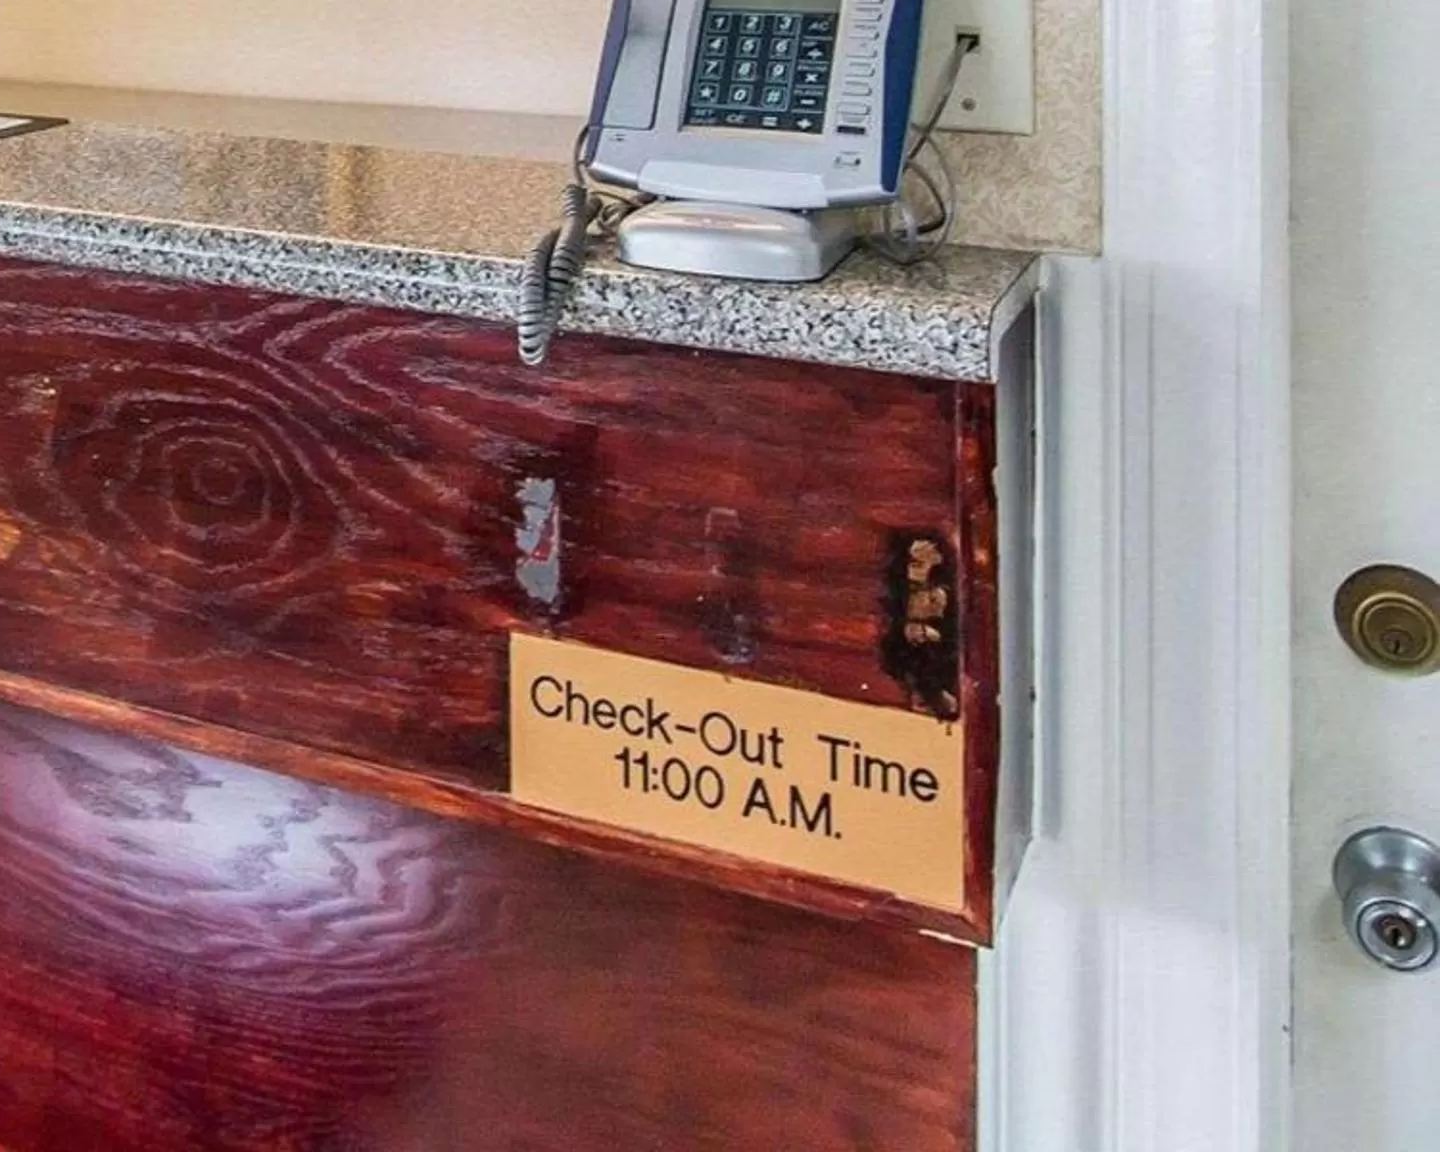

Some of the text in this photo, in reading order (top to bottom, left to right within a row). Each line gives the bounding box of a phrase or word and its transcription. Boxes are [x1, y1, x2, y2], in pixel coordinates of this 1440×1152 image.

[714, 18, 725, 29] 1
[746, 16, 759, 29] 2
[779, 16, 792, 30] 3
[776, 39, 788, 53] 6
[706, 60, 718, 73] 7
[772, 63, 785, 77] 9
[531, 675, 939, 802] Check-Out Time
[615, 747, 842, 840] 11:00 A.M.
